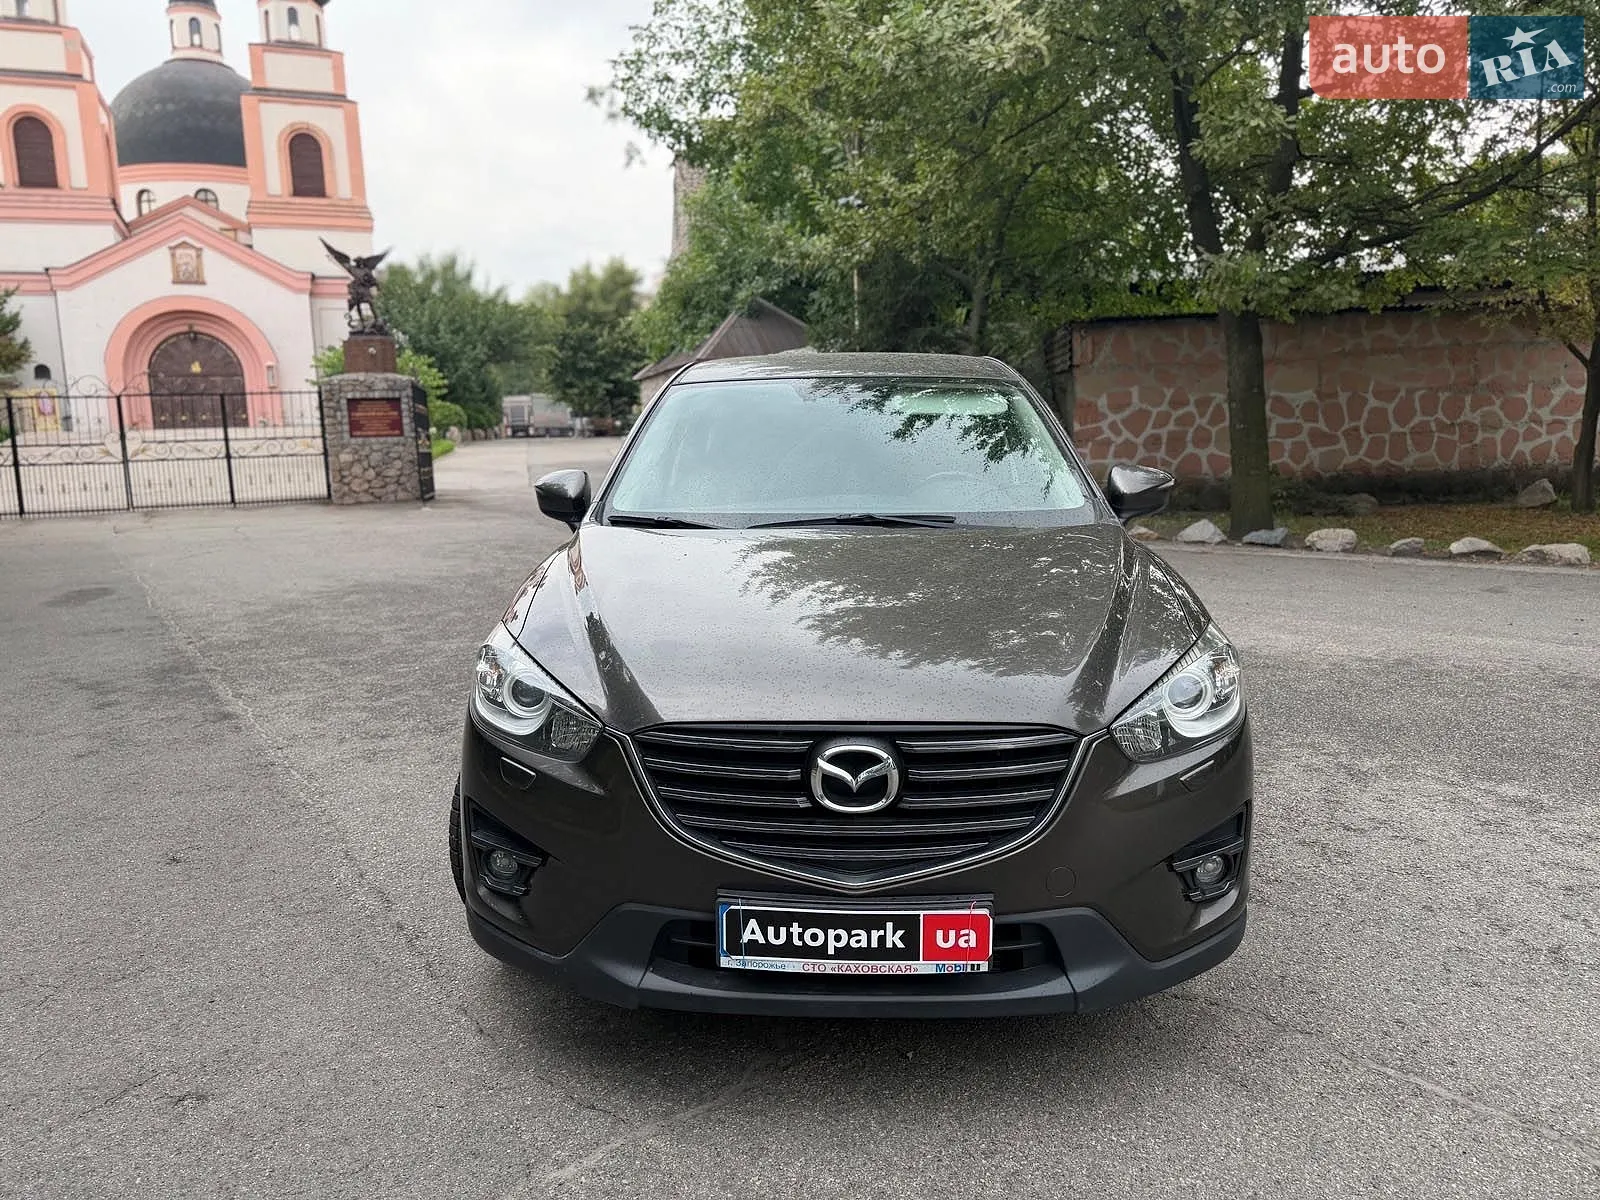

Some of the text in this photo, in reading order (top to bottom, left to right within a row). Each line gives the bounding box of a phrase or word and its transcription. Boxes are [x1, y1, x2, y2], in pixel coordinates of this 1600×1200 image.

[740, 918, 977, 955] Autopark ua
[802, 963, 827, 973] СТО
[830, 963, 919, 975] «КАХОВСКАЯ»
